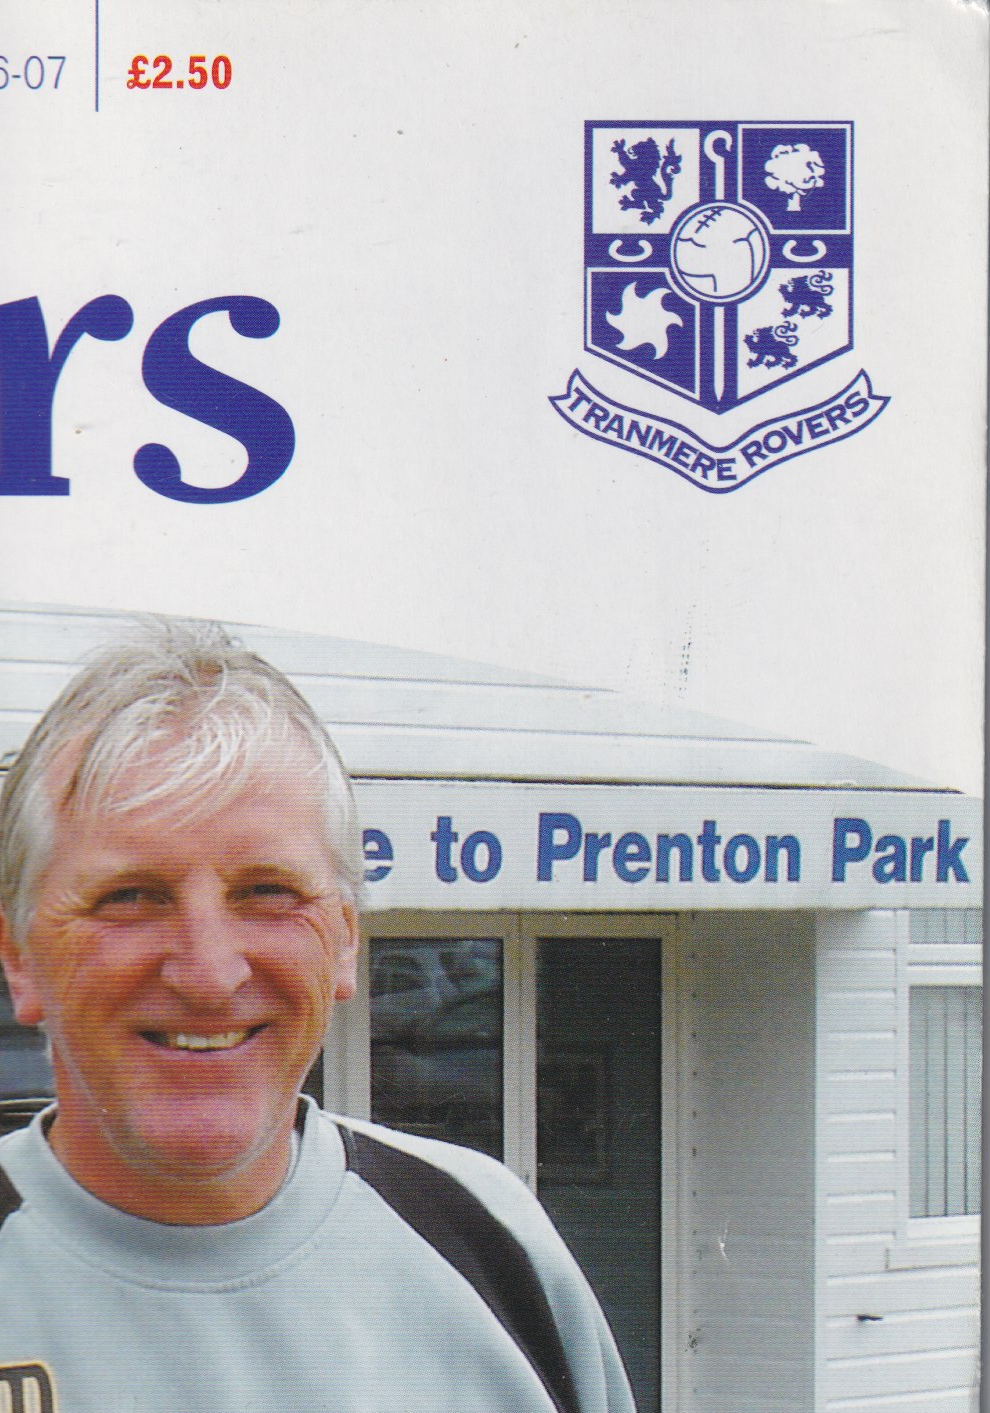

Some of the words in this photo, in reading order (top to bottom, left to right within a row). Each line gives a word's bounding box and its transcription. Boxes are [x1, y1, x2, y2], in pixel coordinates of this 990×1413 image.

[126, 55, 232, 90] £2.50
[567, 386, 737, 482] TRANMERE
[740, 390, 871, 469] ROVERS
[431, 815, 503, 883] to
[536, 812, 802, 884] Prenton
[831, 817, 970, 884] Park
